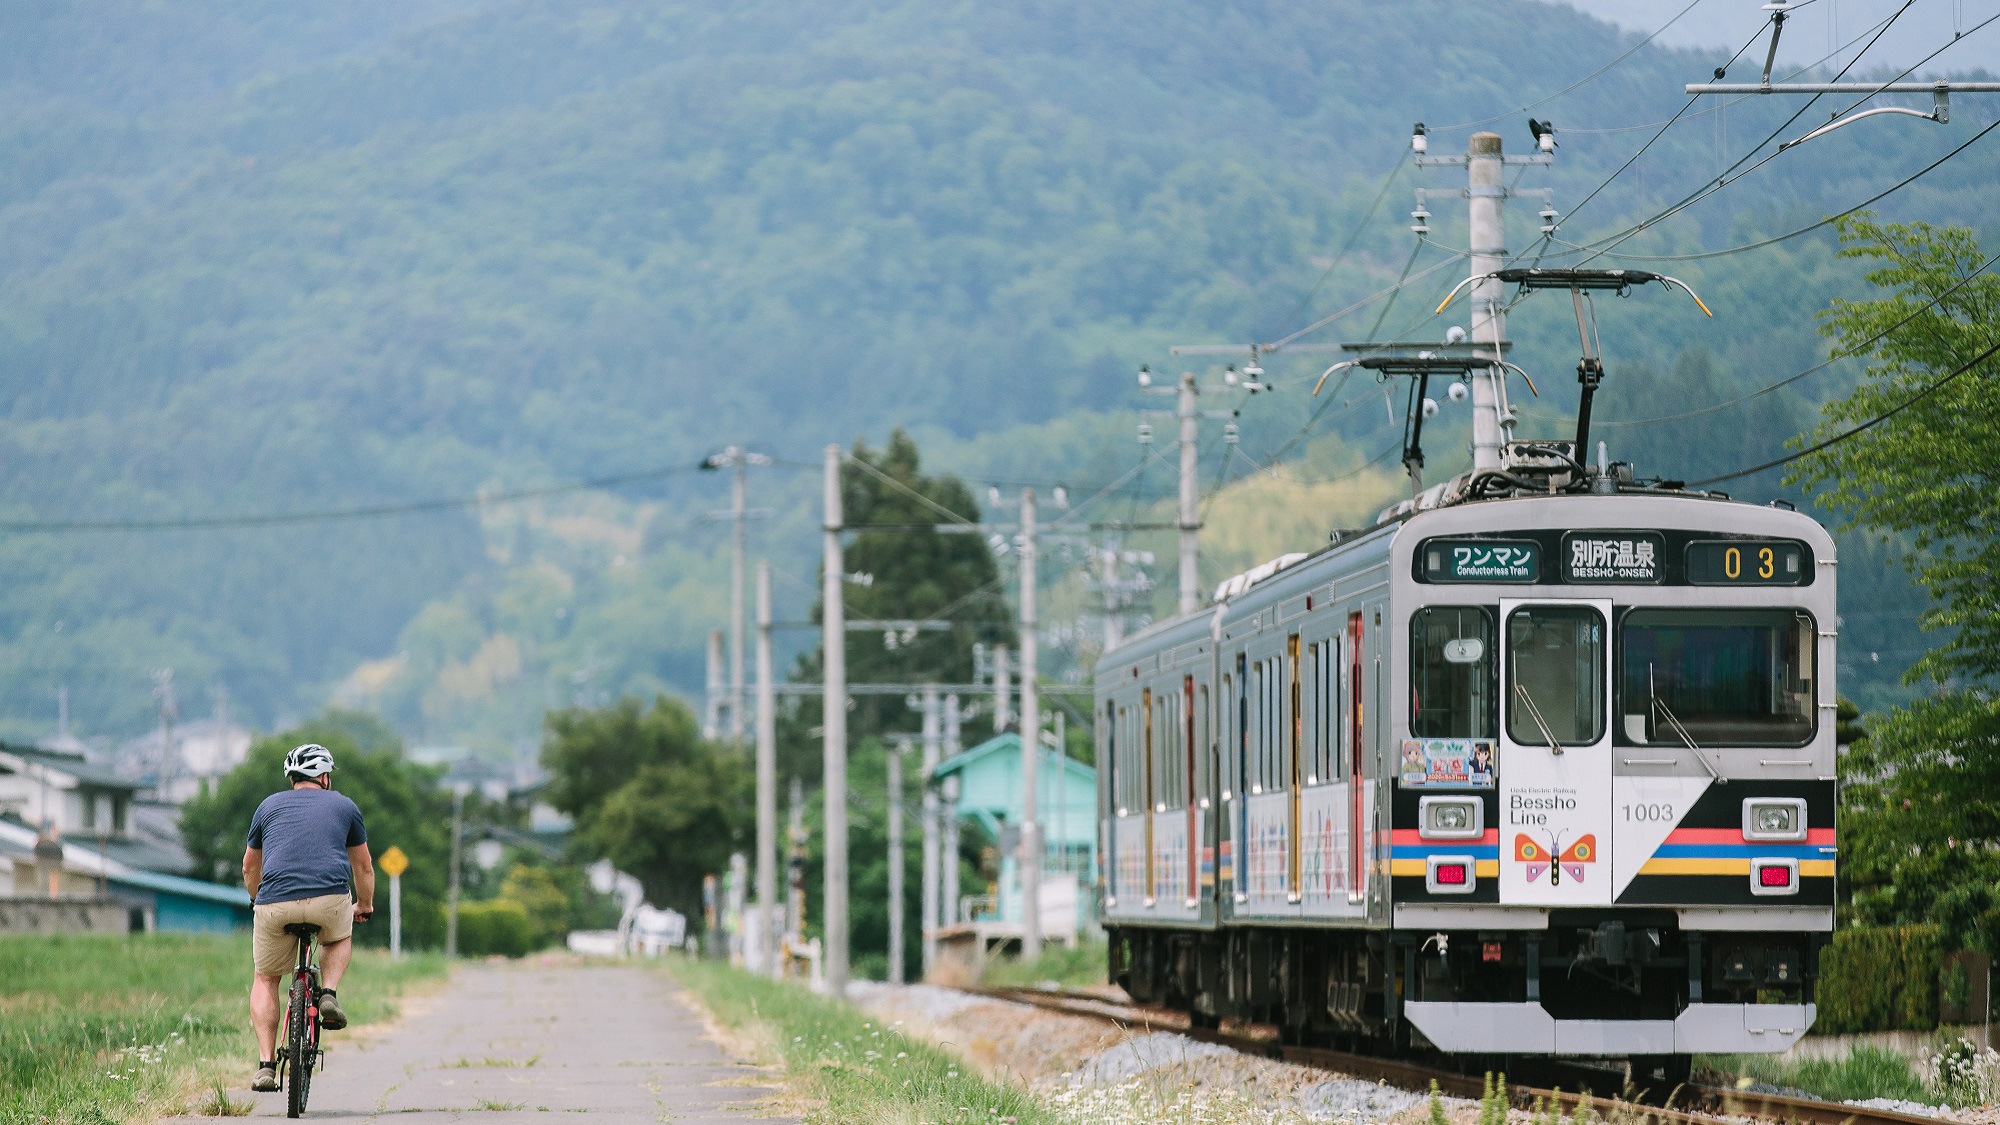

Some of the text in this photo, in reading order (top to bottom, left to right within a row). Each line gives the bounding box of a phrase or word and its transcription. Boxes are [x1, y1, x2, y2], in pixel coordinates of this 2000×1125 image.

[1454, 547, 1531, 566] ワンマン
[1570, 540, 1656, 568] 別所温泉
[1456, 565, 1529, 576] Conductorless Train
[1572, 567, 1654, 578] BESSHO-ONSEN
[1510, 794, 1577, 810] Bessho
[1510, 809, 1547, 825] Line
[1622, 803, 1674, 822] 1003
